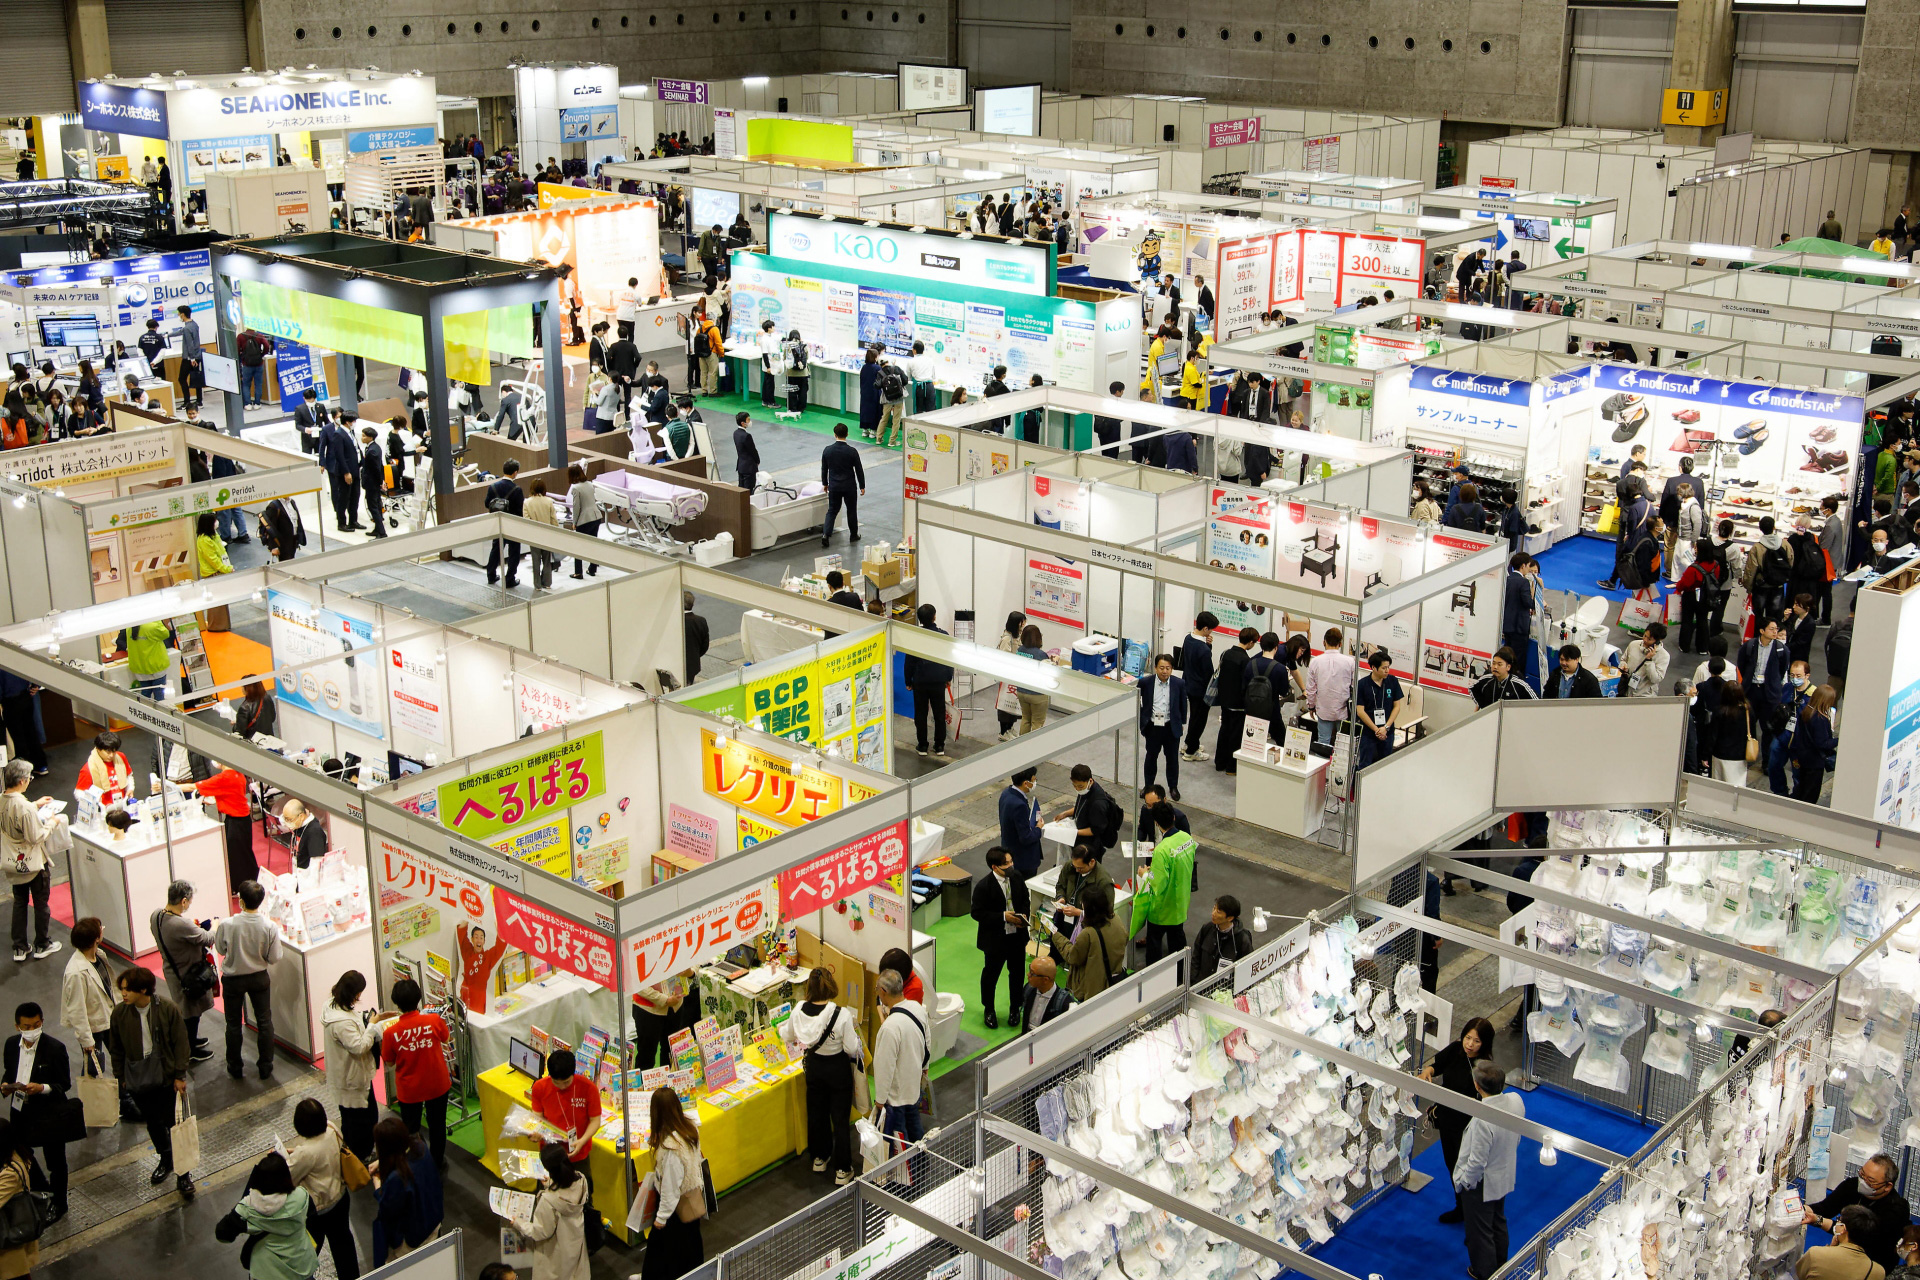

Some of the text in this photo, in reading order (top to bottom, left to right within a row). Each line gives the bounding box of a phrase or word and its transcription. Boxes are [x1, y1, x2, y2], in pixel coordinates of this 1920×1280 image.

[573, 85, 602, 96] CAPE
[661, 81, 691, 91] セミナー会場
[695, 84, 704, 103] 3
[221, 90, 392, 115] SEAHONENCE Inc.
[664, 91, 689, 102] SEMINAR
[1713, 91, 1722, 110] 6
[86, 99, 161, 122] シーホネンス株式会社
[563, 114, 590, 123] Anymo
[266, 114, 353, 128] シーホネンス株式会社
[1213, 123, 1244, 133] セミナー会場
[1249, 119, 1257, 143] 2
[368, 131, 416, 141] 介護テクノロジー
[1215, 134, 1241, 146] SEMINAR
[33, 293, 56, 301] 未来の
[153, 285, 189, 301] Blue
[1356, 288, 1378, 296] CHARM
[1416, 405, 1518, 430] サンプルコーナー
[4, 455, 53, 469] 介護住宅専門
[60, 445, 169, 476] 株式会社ペリドット
[14, 463, 55, 484] eridot
[231, 484, 256, 497] Peridot
[1091, 549, 1153, 571] 日本セイフティー株式会社
[272, 604, 319, 632] 服を着たまま
[403, 660, 435, 679] 牛乳石鹸
[520, 683, 571, 713] 入浴介助を
[754, 675, 809, 712] BCP
[128, 706, 182, 736] 牛乳石鹸共進社株式会社
[521, 701, 570, 725] もっとスムー
[458, 740, 586, 792] 訪問介護に役立つ! 研修資料に使える!
[452, 757, 590, 827] へるぱる
[713, 753, 829, 821] レクリエ
[795, 827, 897, 878] 訪問介護事業所をまるごとサポートする情報誌
[885, 843, 897, 854] 好評
[449, 845, 519, 883] 株式会社世界文化ワンダーグループ
[383, 852, 457, 909] レクリエ
[789, 850, 878, 901] へるぱる
[632, 888, 762, 952] 高齢者介護をサポートするレクリエーション情報誌
[740, 912, 761, 928] 発売中!
[743, 904, 758, 917] 好評
[596, 918, 615, 931] 3-503
[505, 911, 588, 973] へるぱる
[636, 915, 732, 984] レクリエ
[594, 950, 606, 961] 好評
[1250, 937, 1296, 978] 尿とりパッド
[393, 1025, 433, 1043] レクリエ
[398, 1038, 433, 1053] へるぱる
